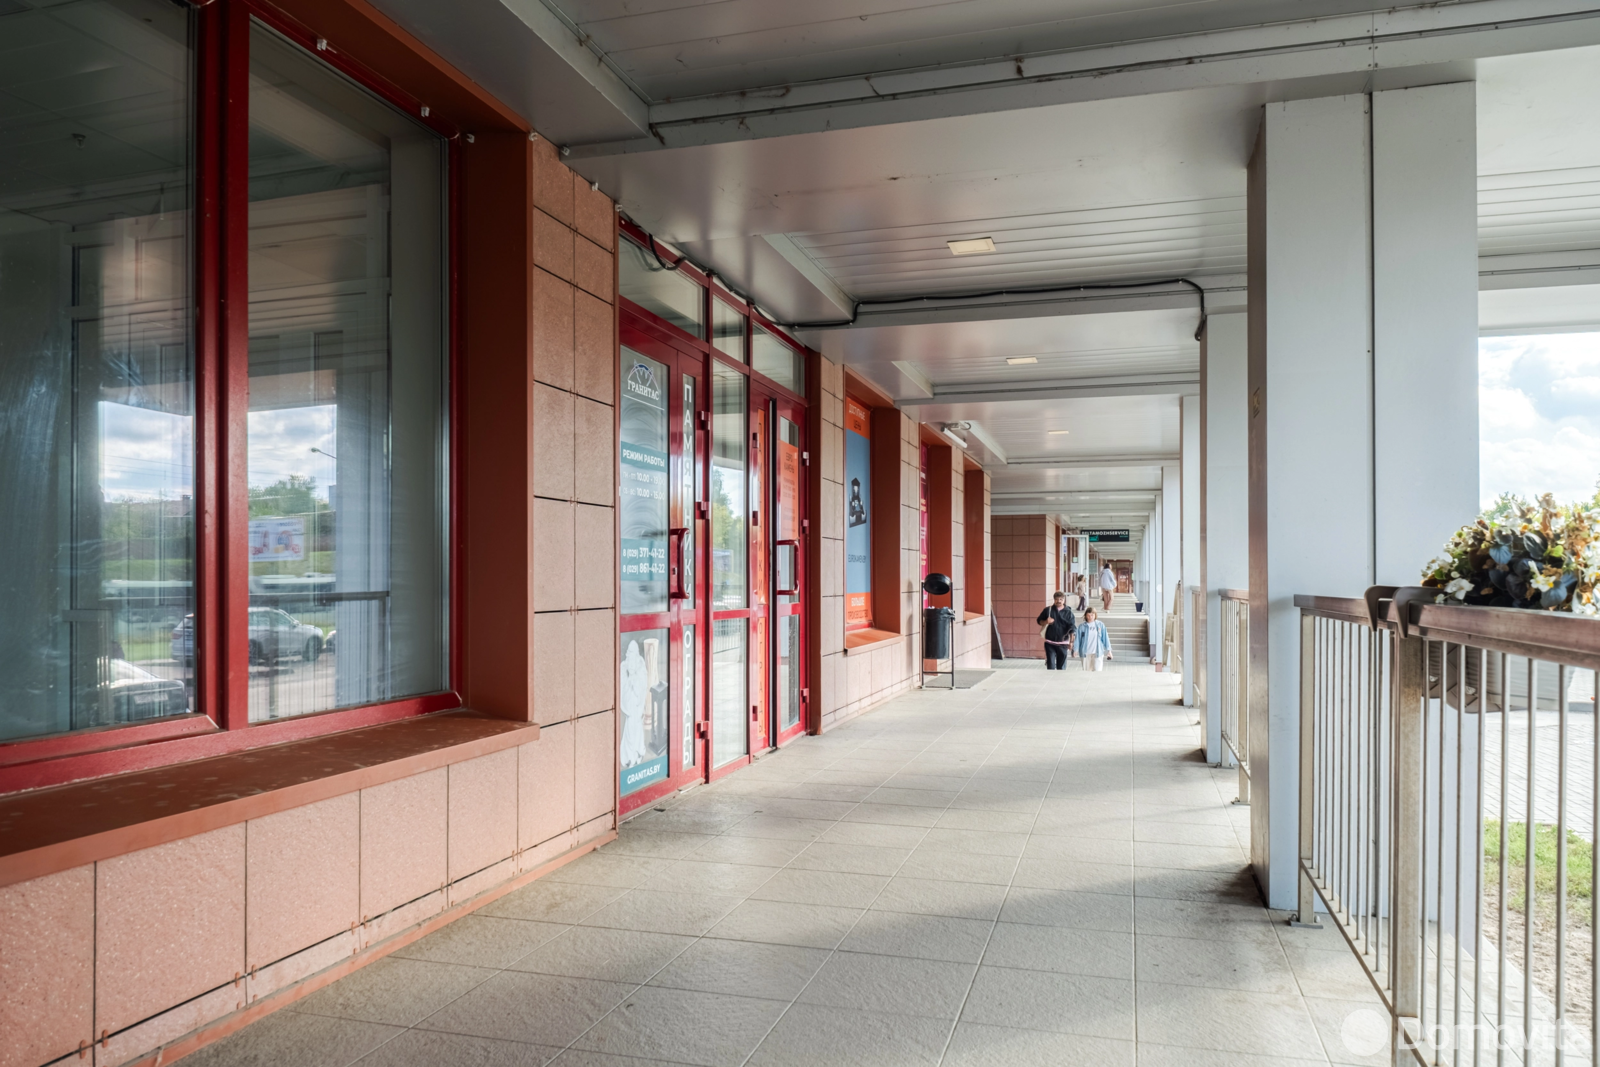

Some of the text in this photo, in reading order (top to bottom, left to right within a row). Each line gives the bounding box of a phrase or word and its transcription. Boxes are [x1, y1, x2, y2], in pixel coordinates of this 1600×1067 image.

[627, 380, 660, 401] ГРАНИТАС
[622, 449, 665, 468] РЕЖИМ РАБОТЫ
[636, 472, 650, 482] 10.00
[636, 487, 650, 498] 10.00
[683, 384, 692, 600] ПАМЯТНИКИ
[639, 547, 665, 559] 371-41-22
[639, 562, 665, 573] 861-41-22
[683, 630, 692, 765] ОГРАДЫ
[627, 763, 661, 785] GRANITAS.BY
